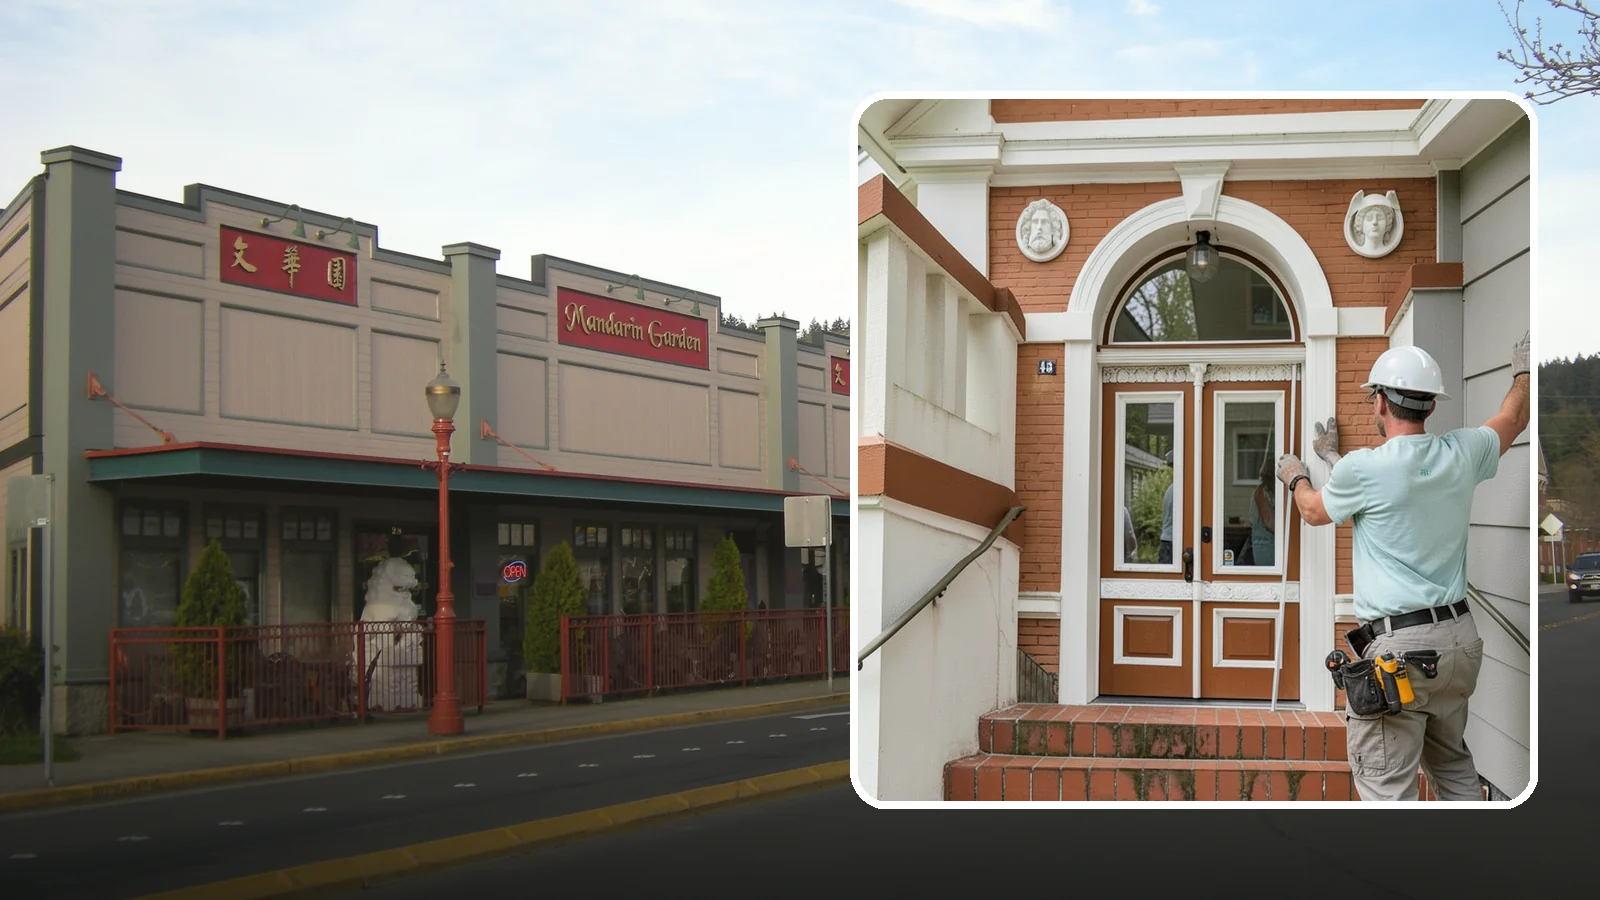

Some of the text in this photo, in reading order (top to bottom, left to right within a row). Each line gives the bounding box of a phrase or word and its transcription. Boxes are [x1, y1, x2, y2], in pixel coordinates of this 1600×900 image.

[230, 235, 346, 291] 文華園
[564, 302, 701, 352] Mandarin Garden
[503, 565, 527, 578] OPEN
